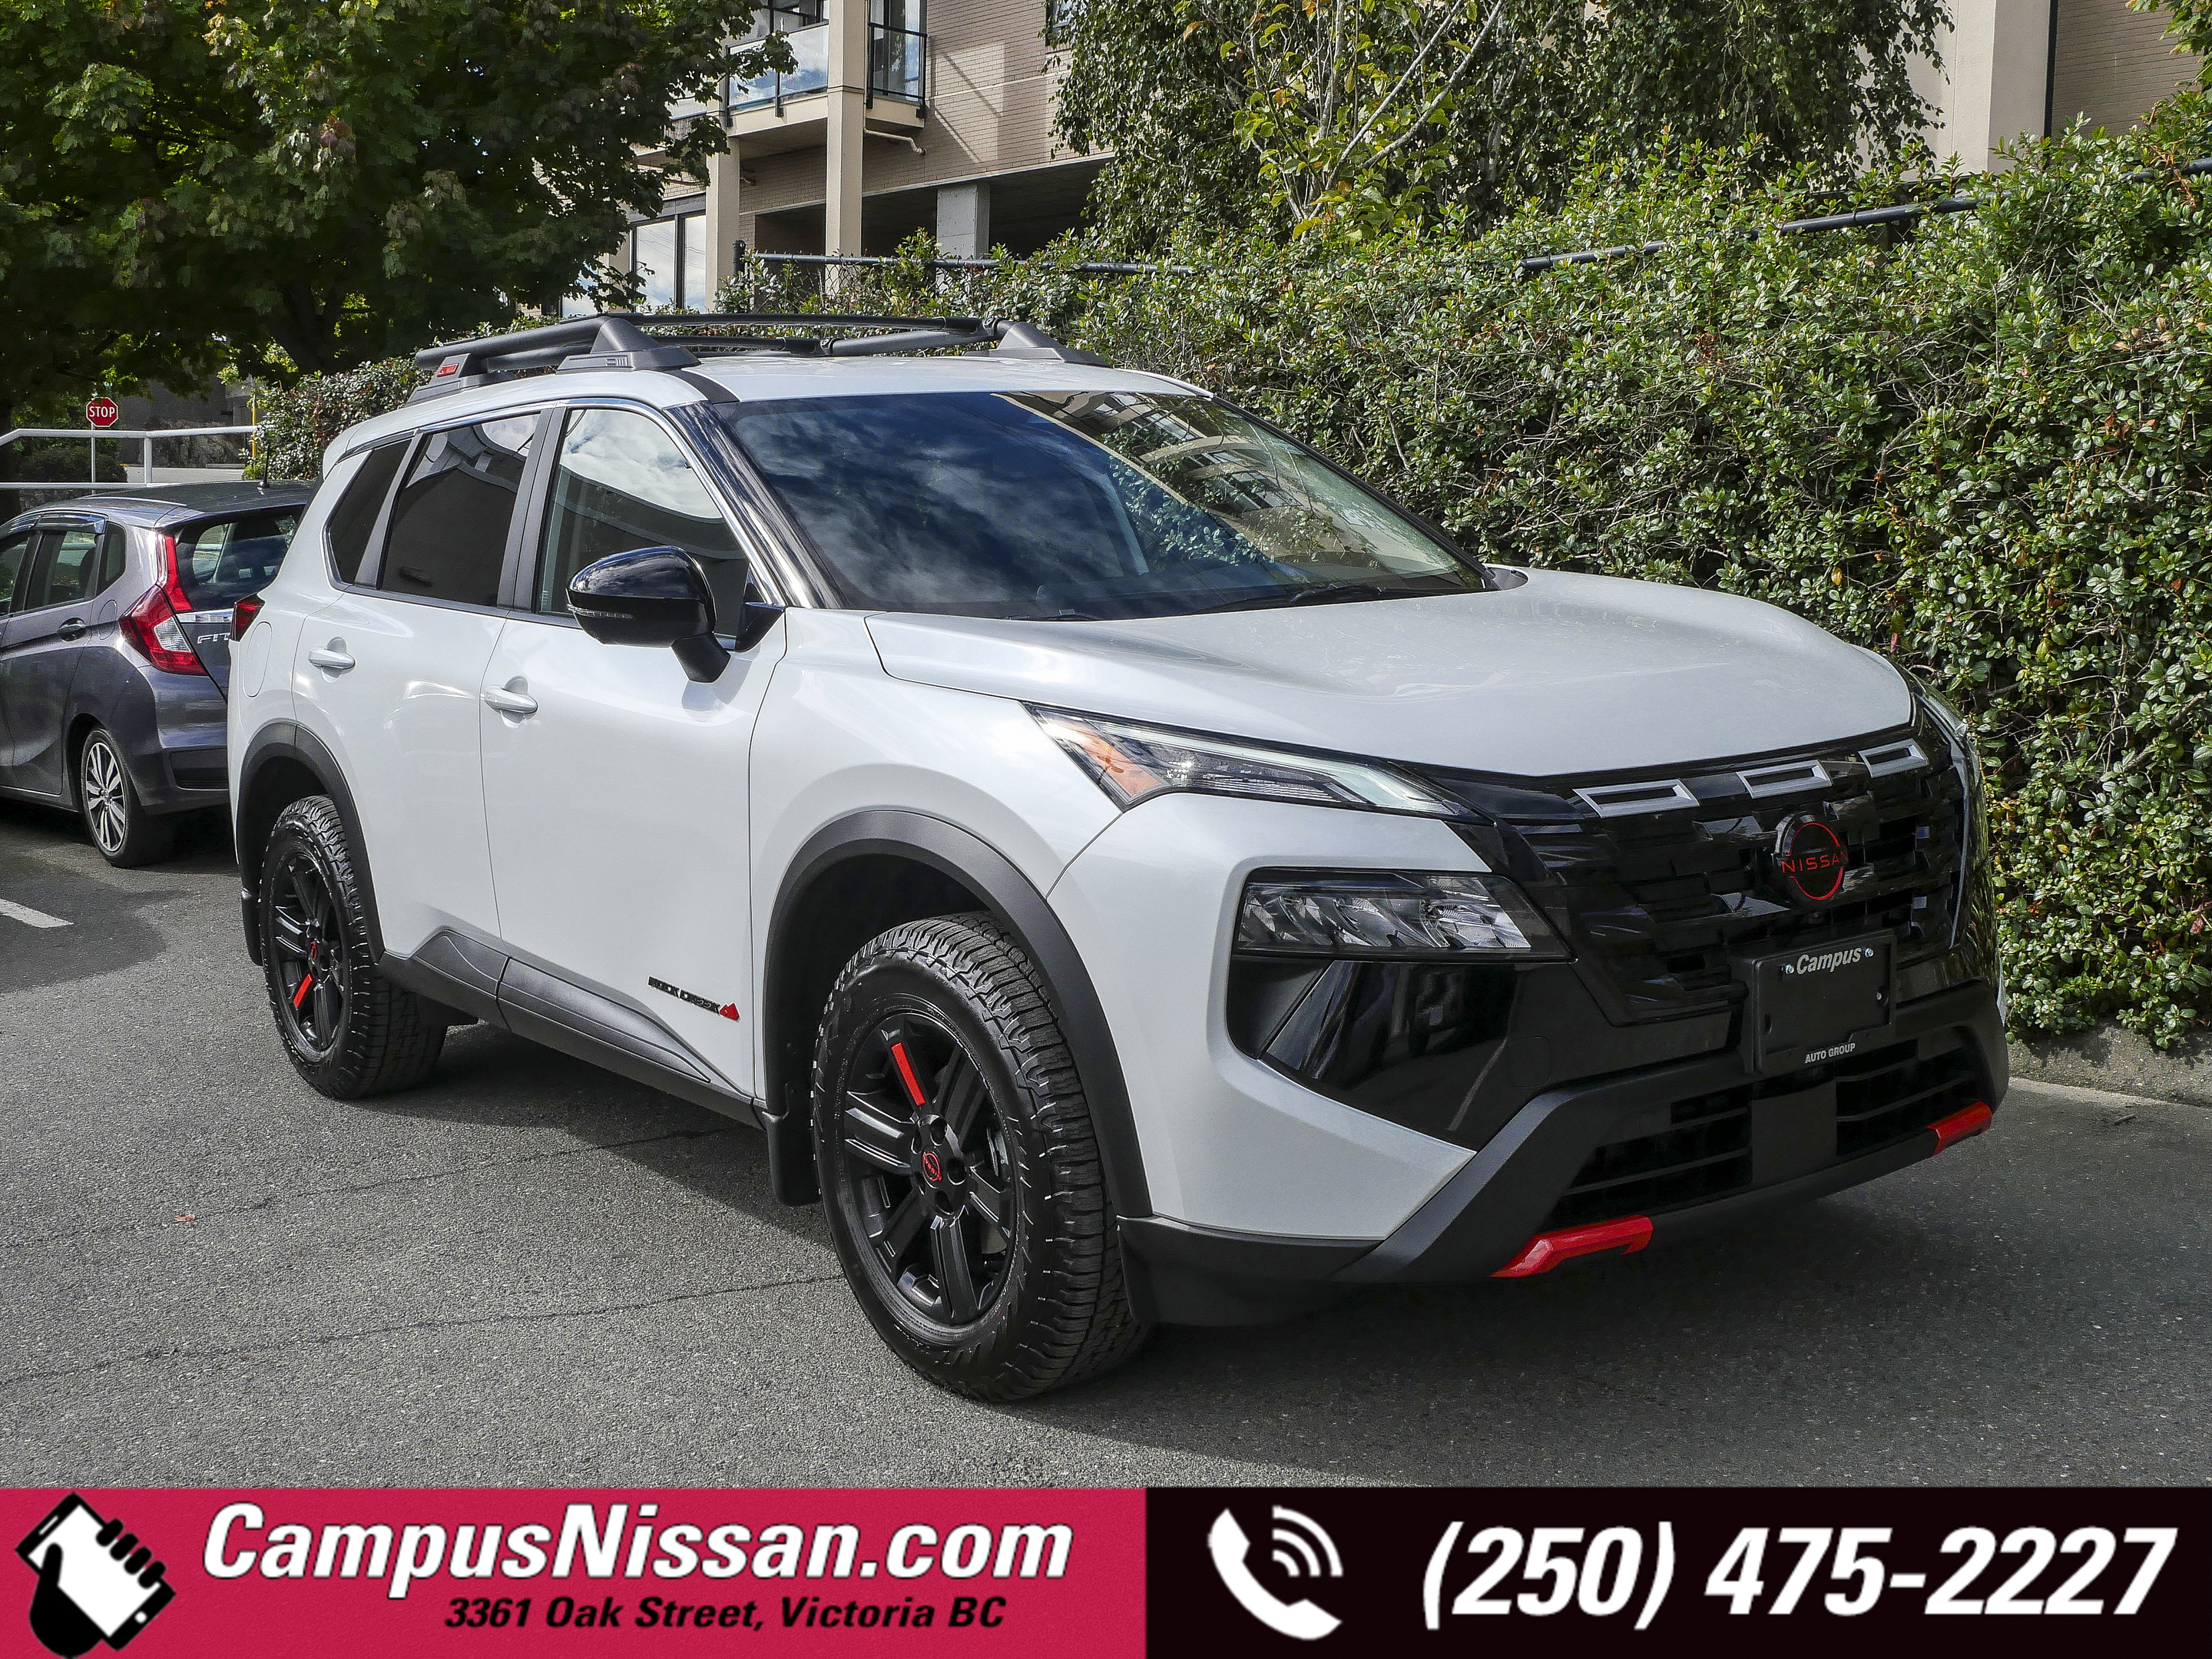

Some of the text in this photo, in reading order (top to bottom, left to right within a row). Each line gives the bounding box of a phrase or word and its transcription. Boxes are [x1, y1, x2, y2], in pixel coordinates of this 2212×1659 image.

[89, 406, 115, 418] STOP
[1781, 851, 1849, 873] NISSAN
[1796, 948, 1862, 975] Campus
[1804, 1042, 1856, 1064] AUTO GROUP
